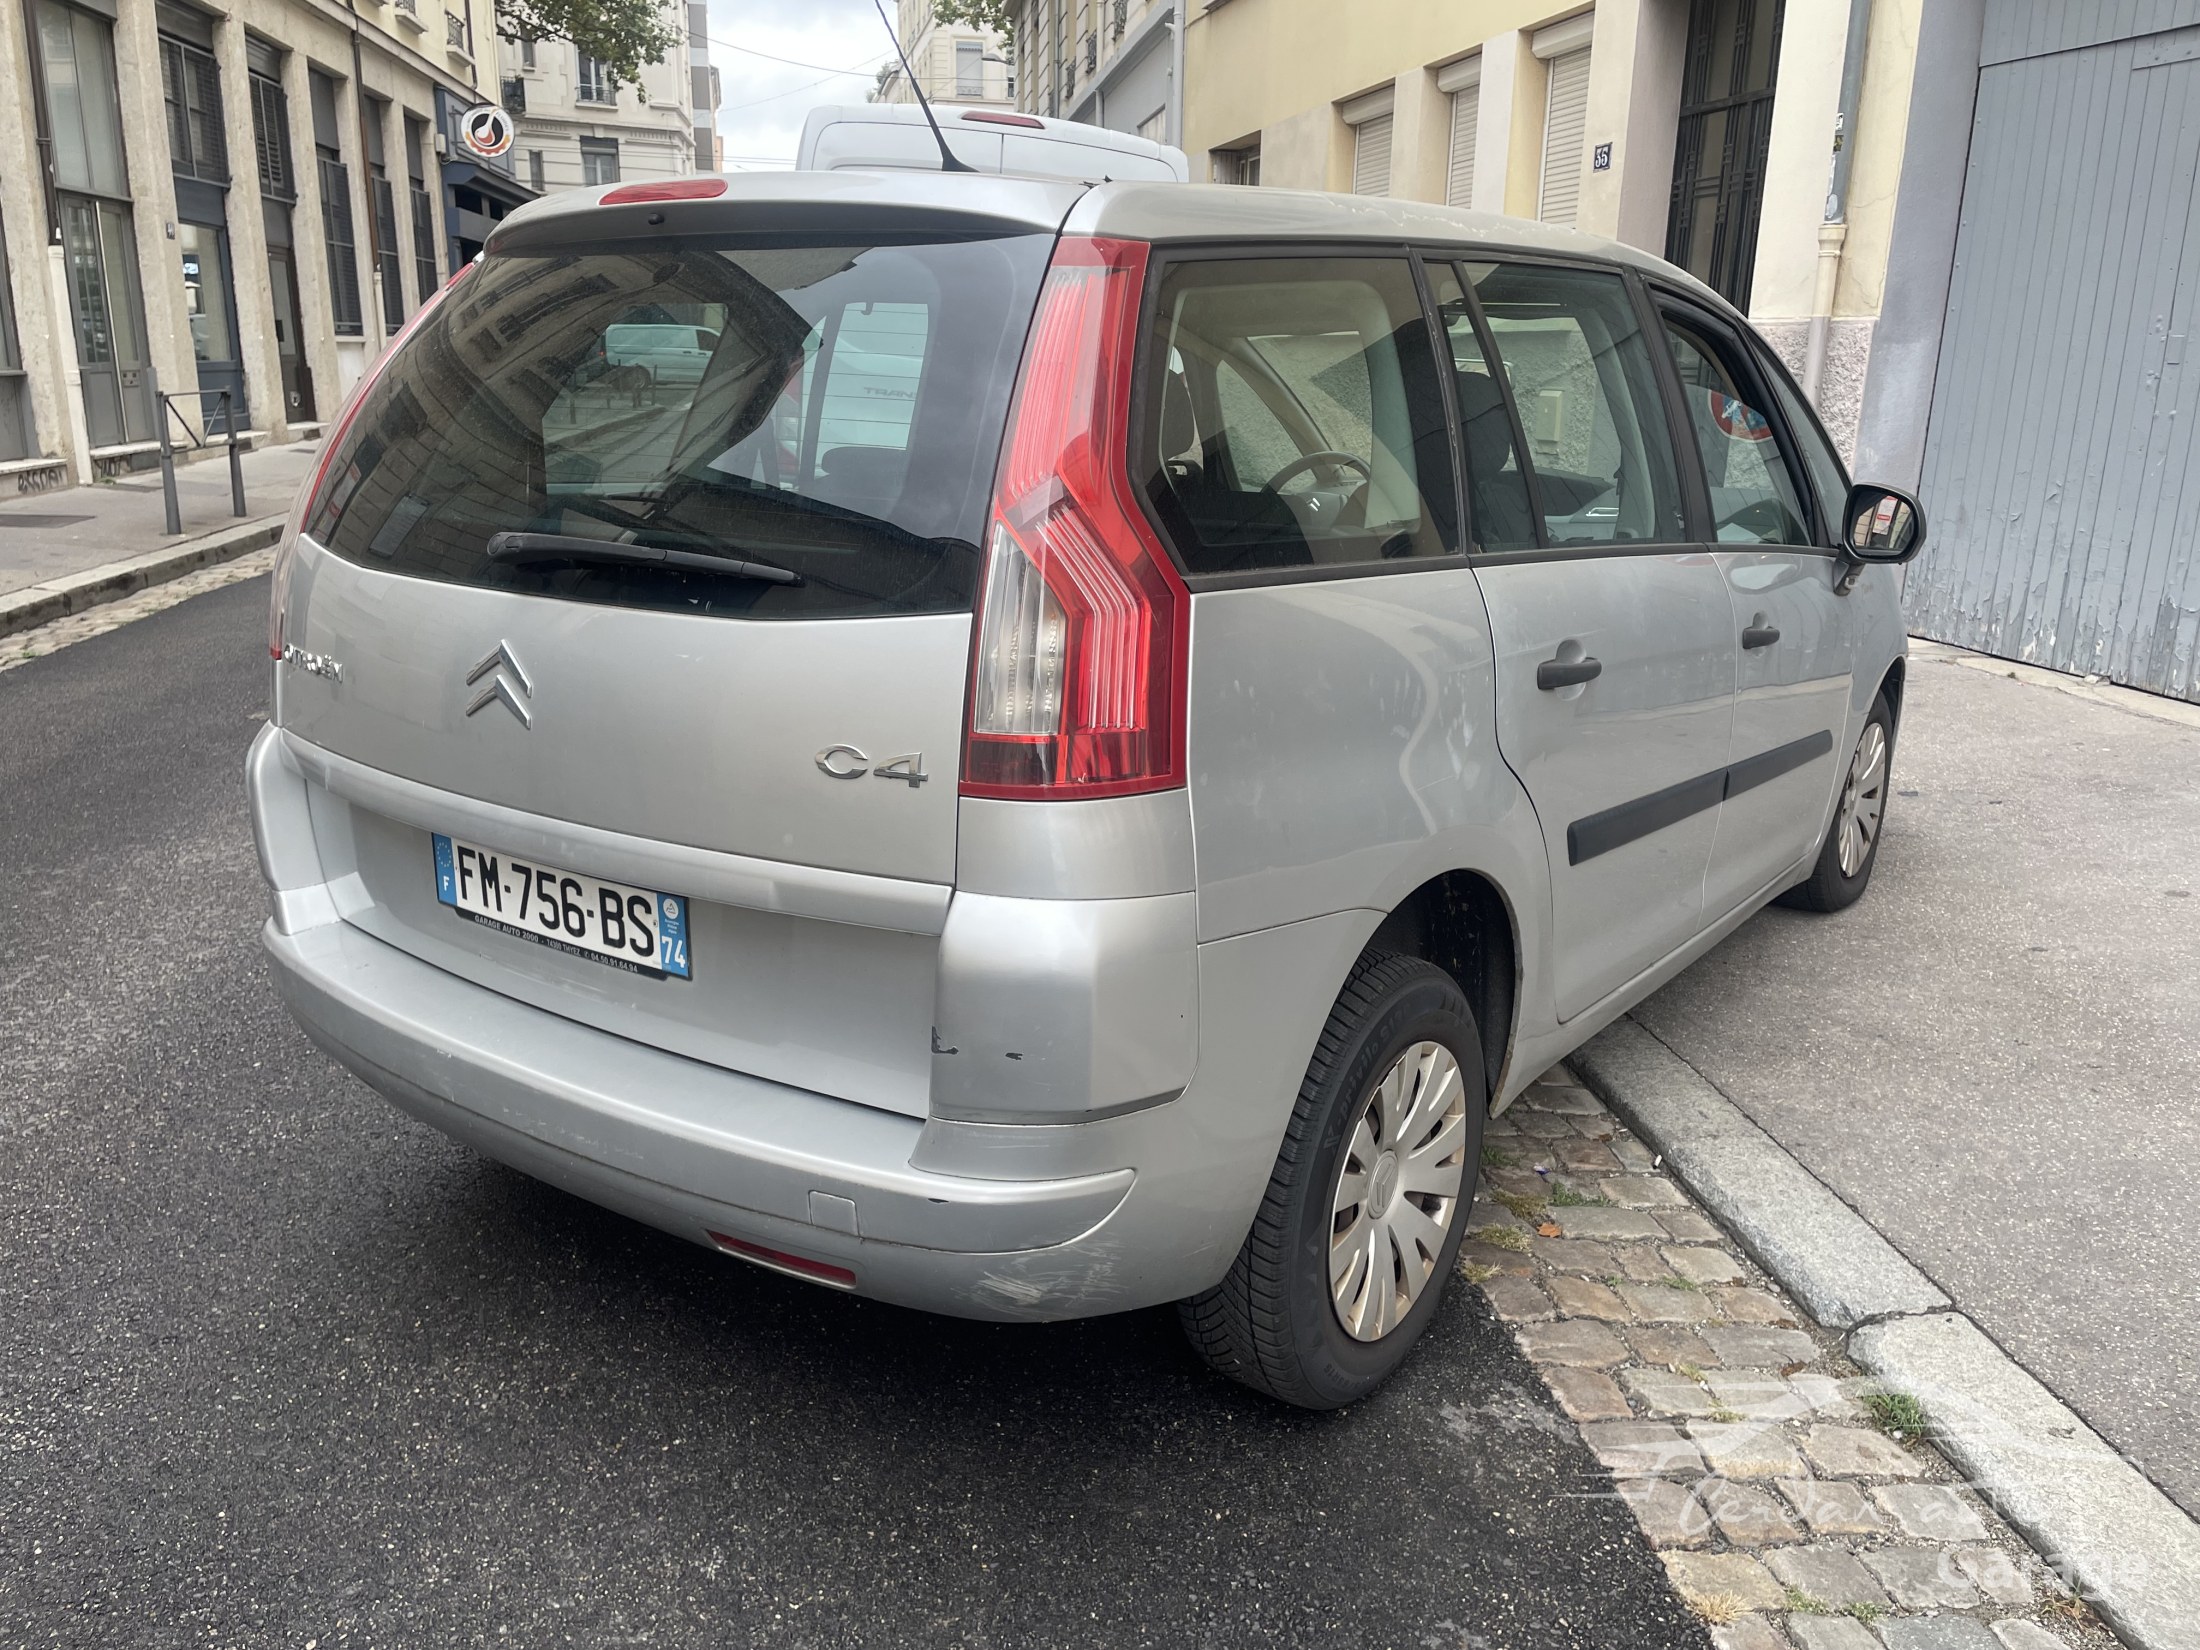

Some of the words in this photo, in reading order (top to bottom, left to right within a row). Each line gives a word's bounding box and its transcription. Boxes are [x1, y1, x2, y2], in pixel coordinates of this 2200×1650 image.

[815, 743, 928, 788] C4
[443, 875, 450, 891] F
[457, 845, 655, 957] FM-756-BS
[474, 914, 501, 930] GARAGE
[502, 924, 520, 937] AUTO
[522, 931, 539, 943] 2000
[661, 935, 686, 968] 74
